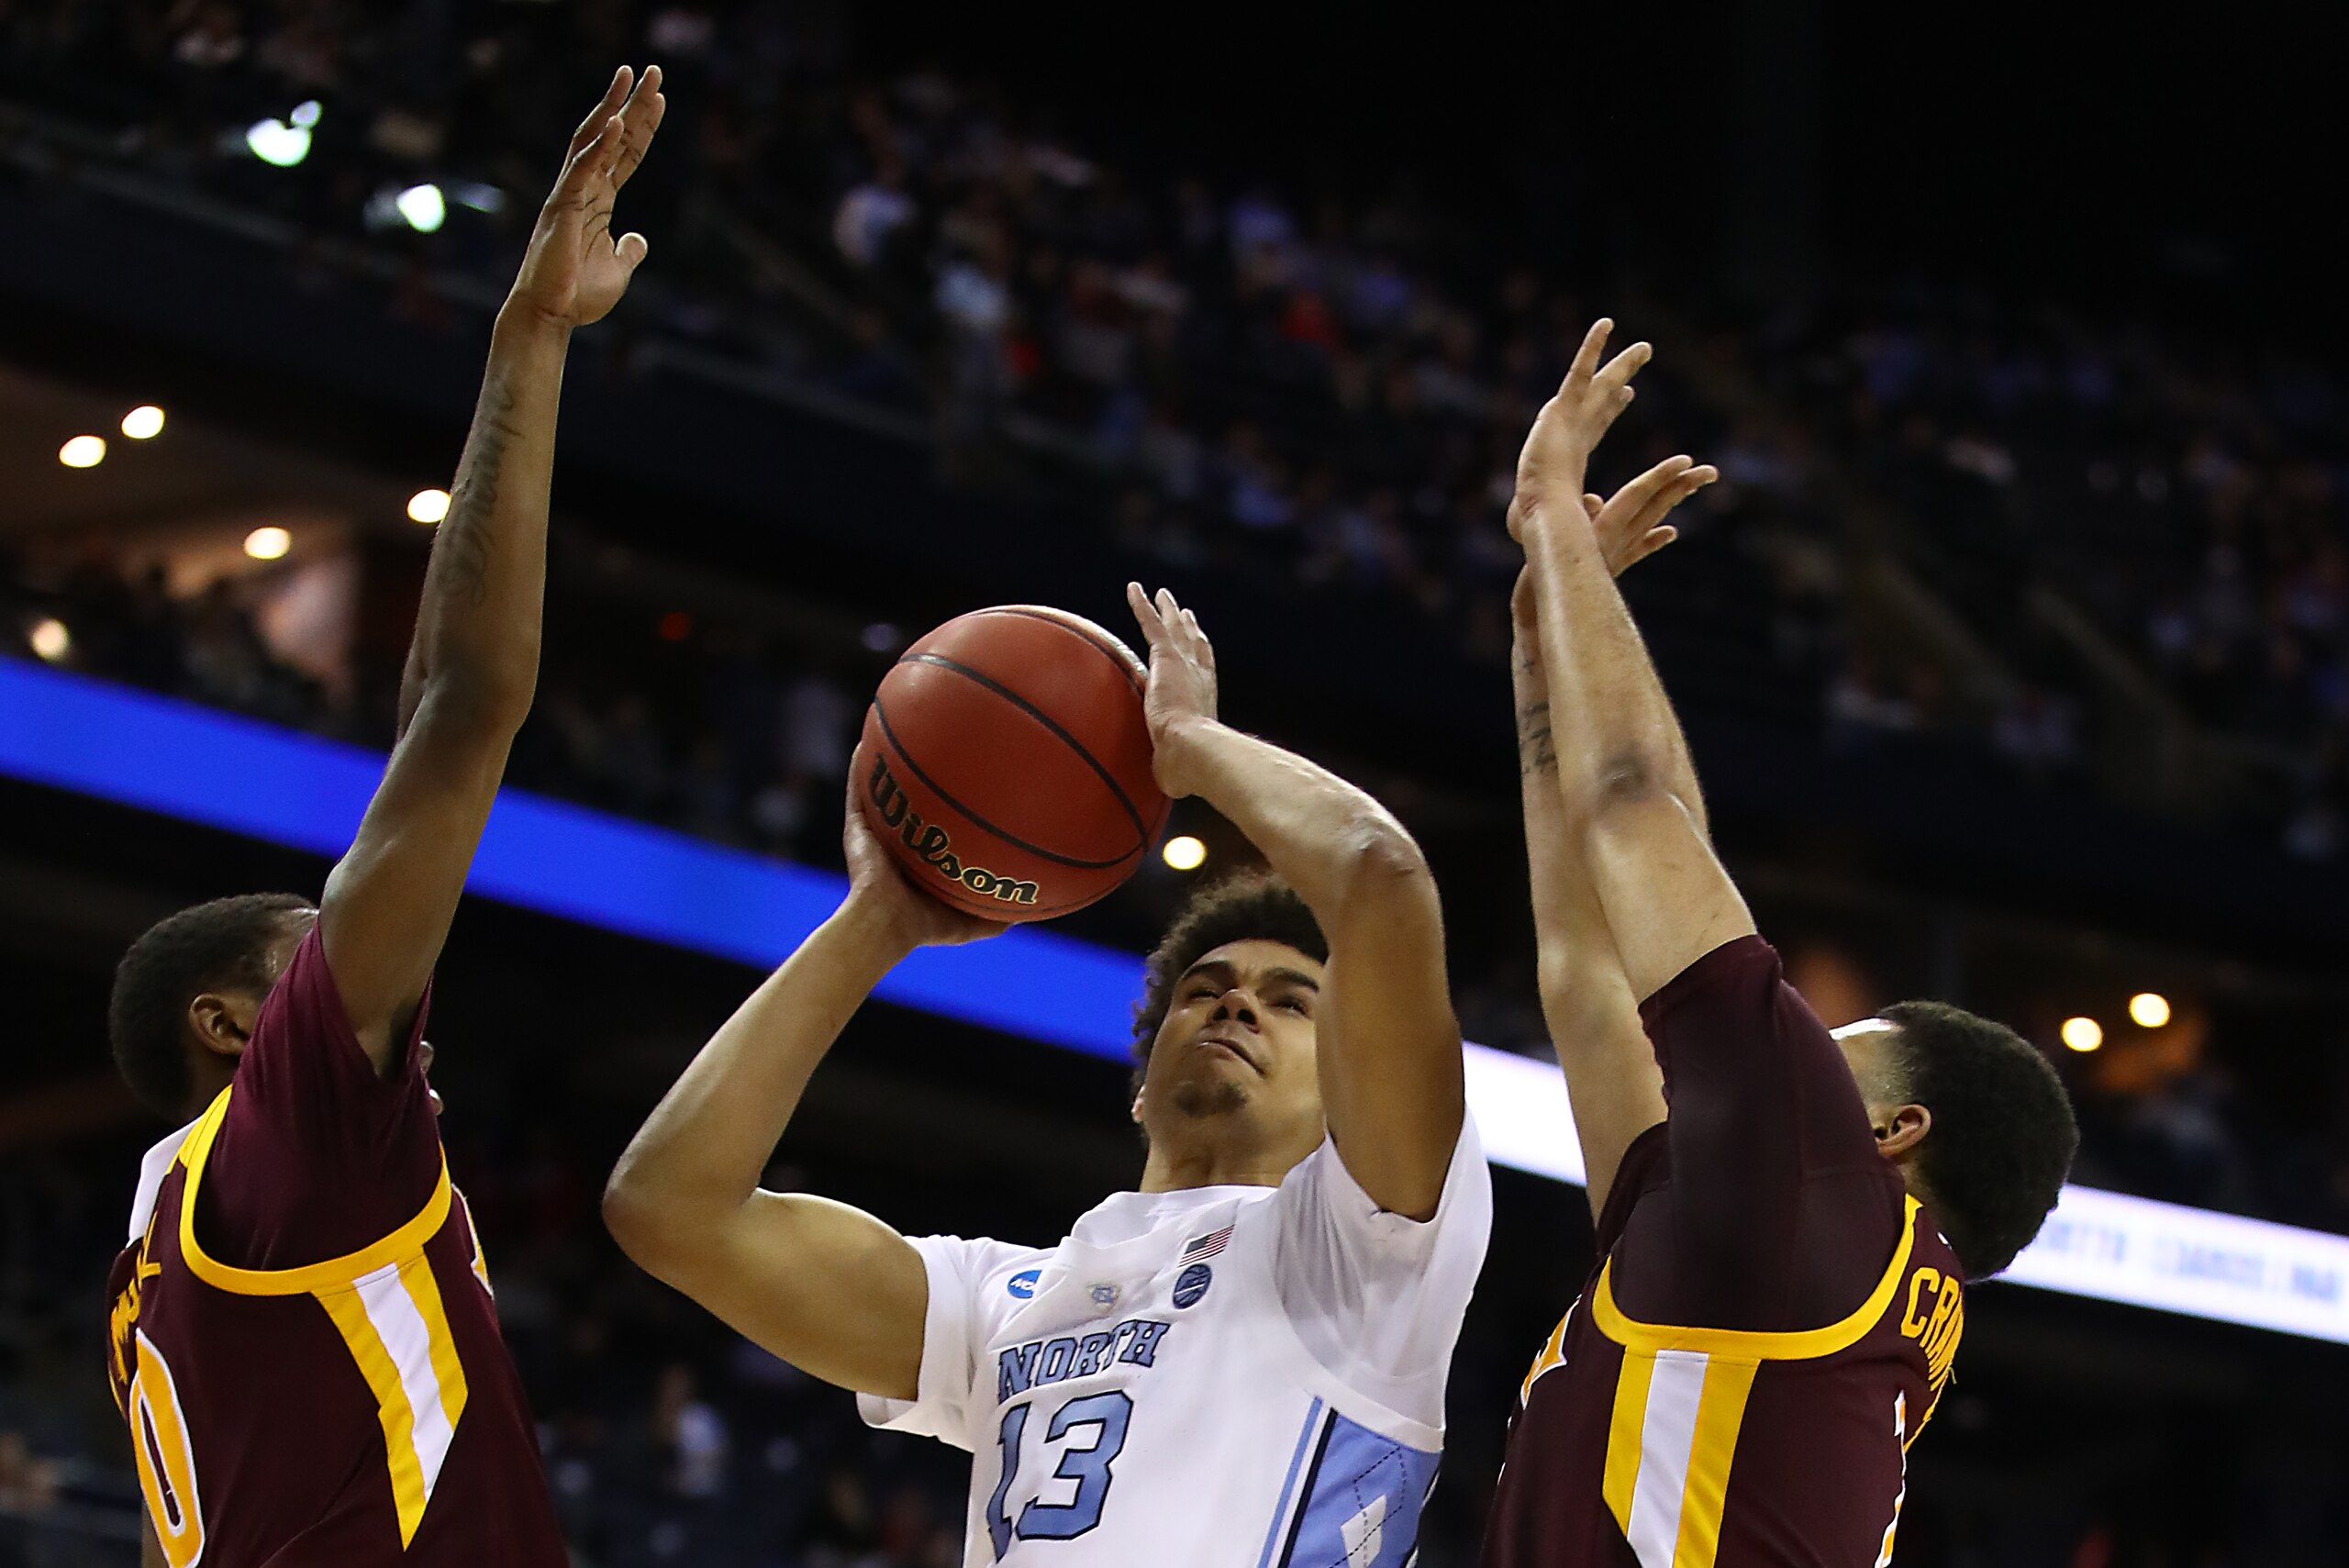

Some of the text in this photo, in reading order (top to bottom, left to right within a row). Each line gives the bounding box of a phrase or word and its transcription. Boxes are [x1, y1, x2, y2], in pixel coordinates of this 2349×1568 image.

[870, 751, 1039, 905] Wilson
[997, 1318, 1171, 1406] NORTH
[986, 1389, 1134, 1563] 13
